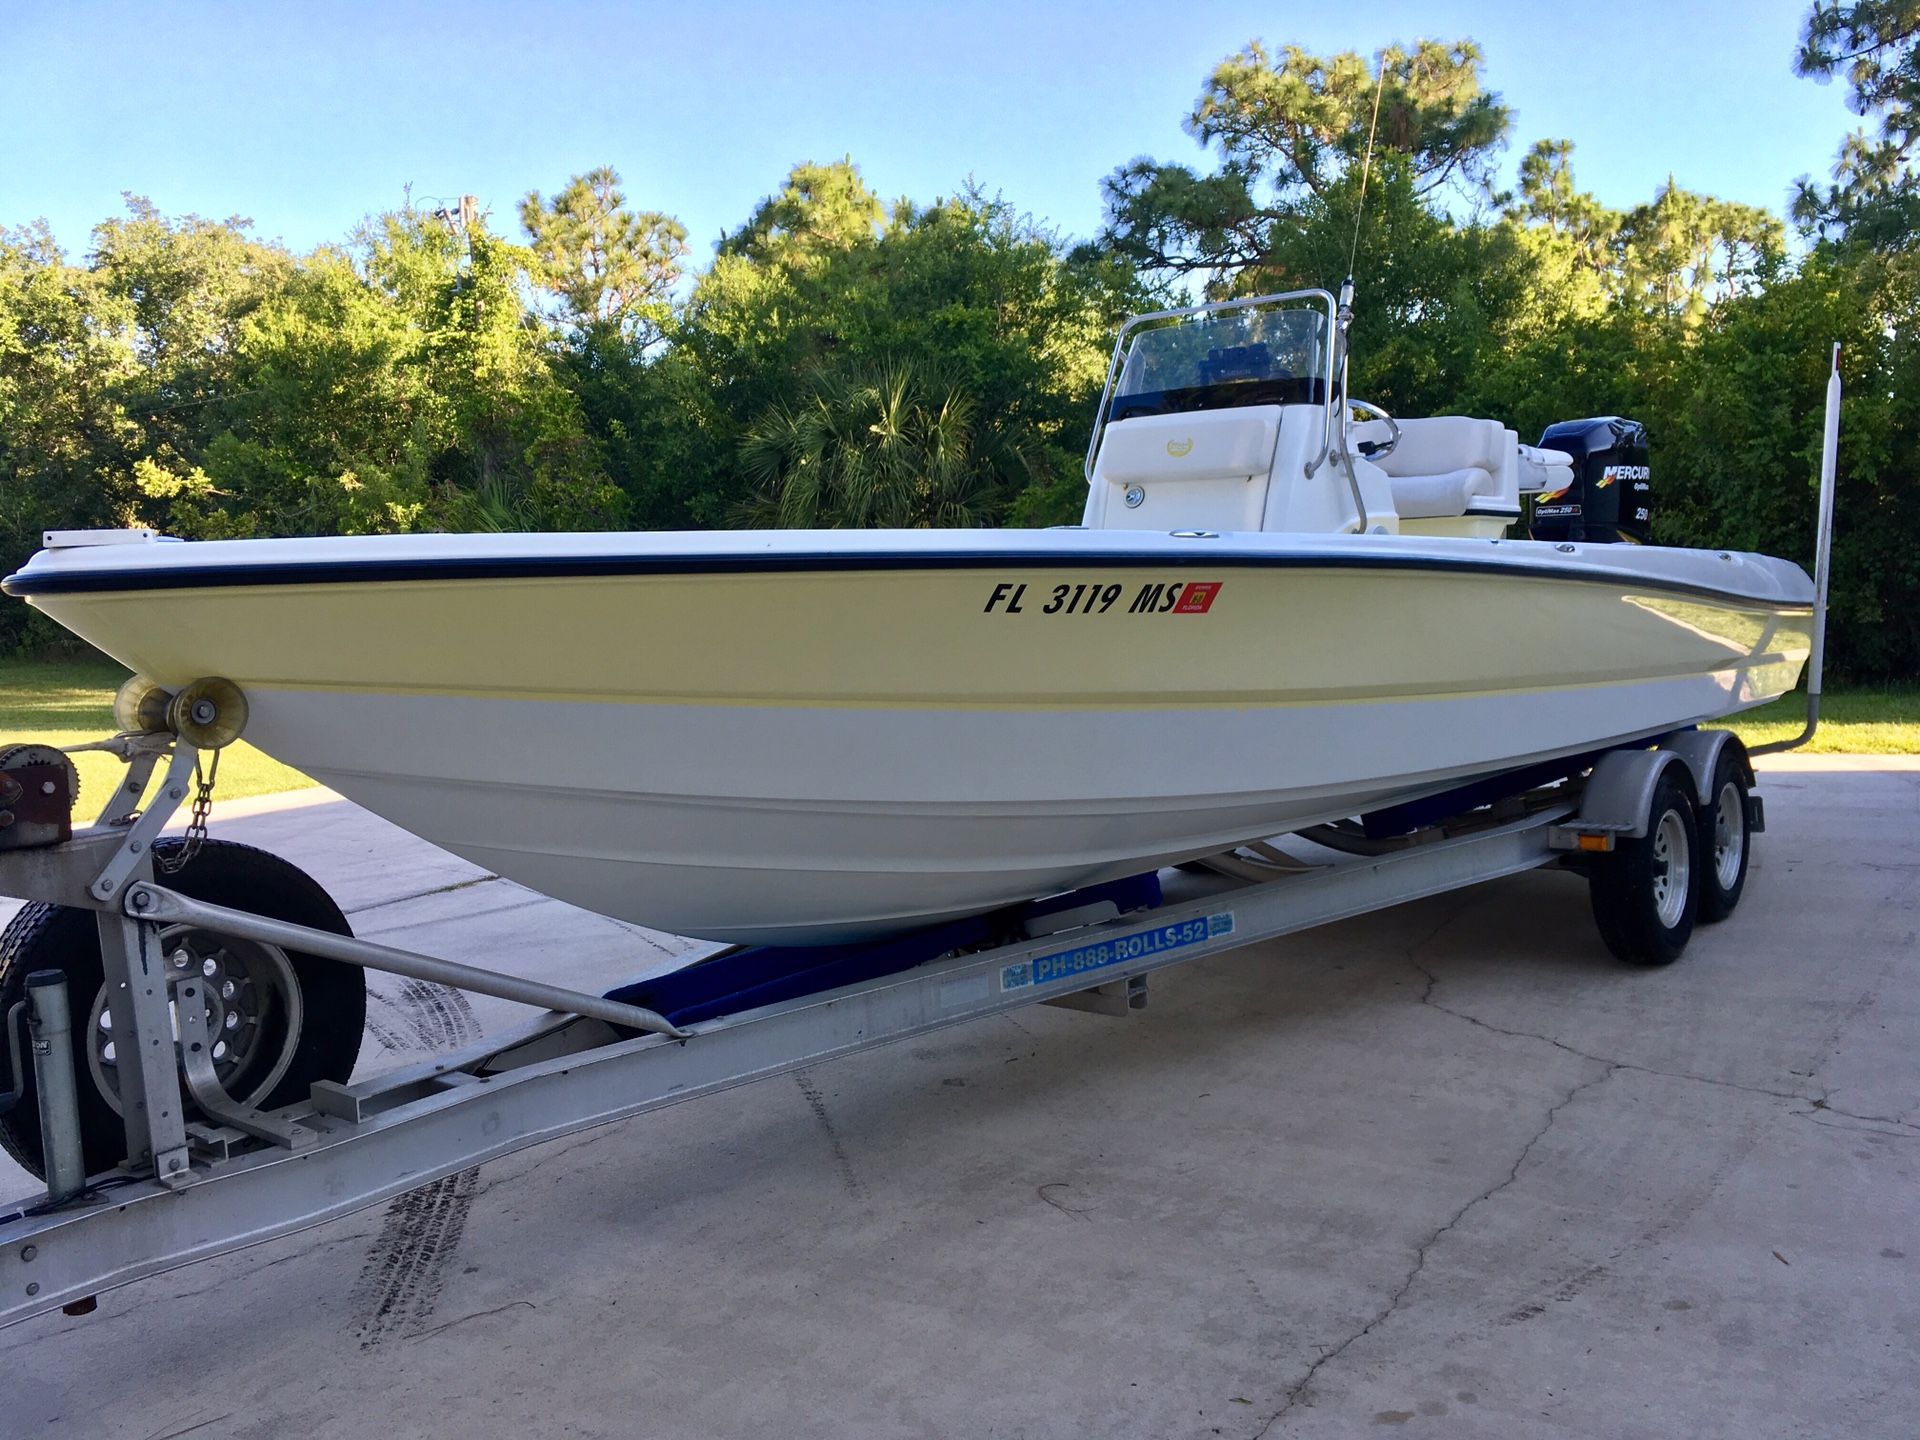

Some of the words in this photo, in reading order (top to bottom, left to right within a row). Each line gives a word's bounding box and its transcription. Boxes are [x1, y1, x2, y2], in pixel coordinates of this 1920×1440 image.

[1603, 465, 1650, 480] MERCUR
[983, 583, 1028, 613] FL
[1043, 584, 1123, 614] 3119
[1128, 582, 1184, 613] MS
